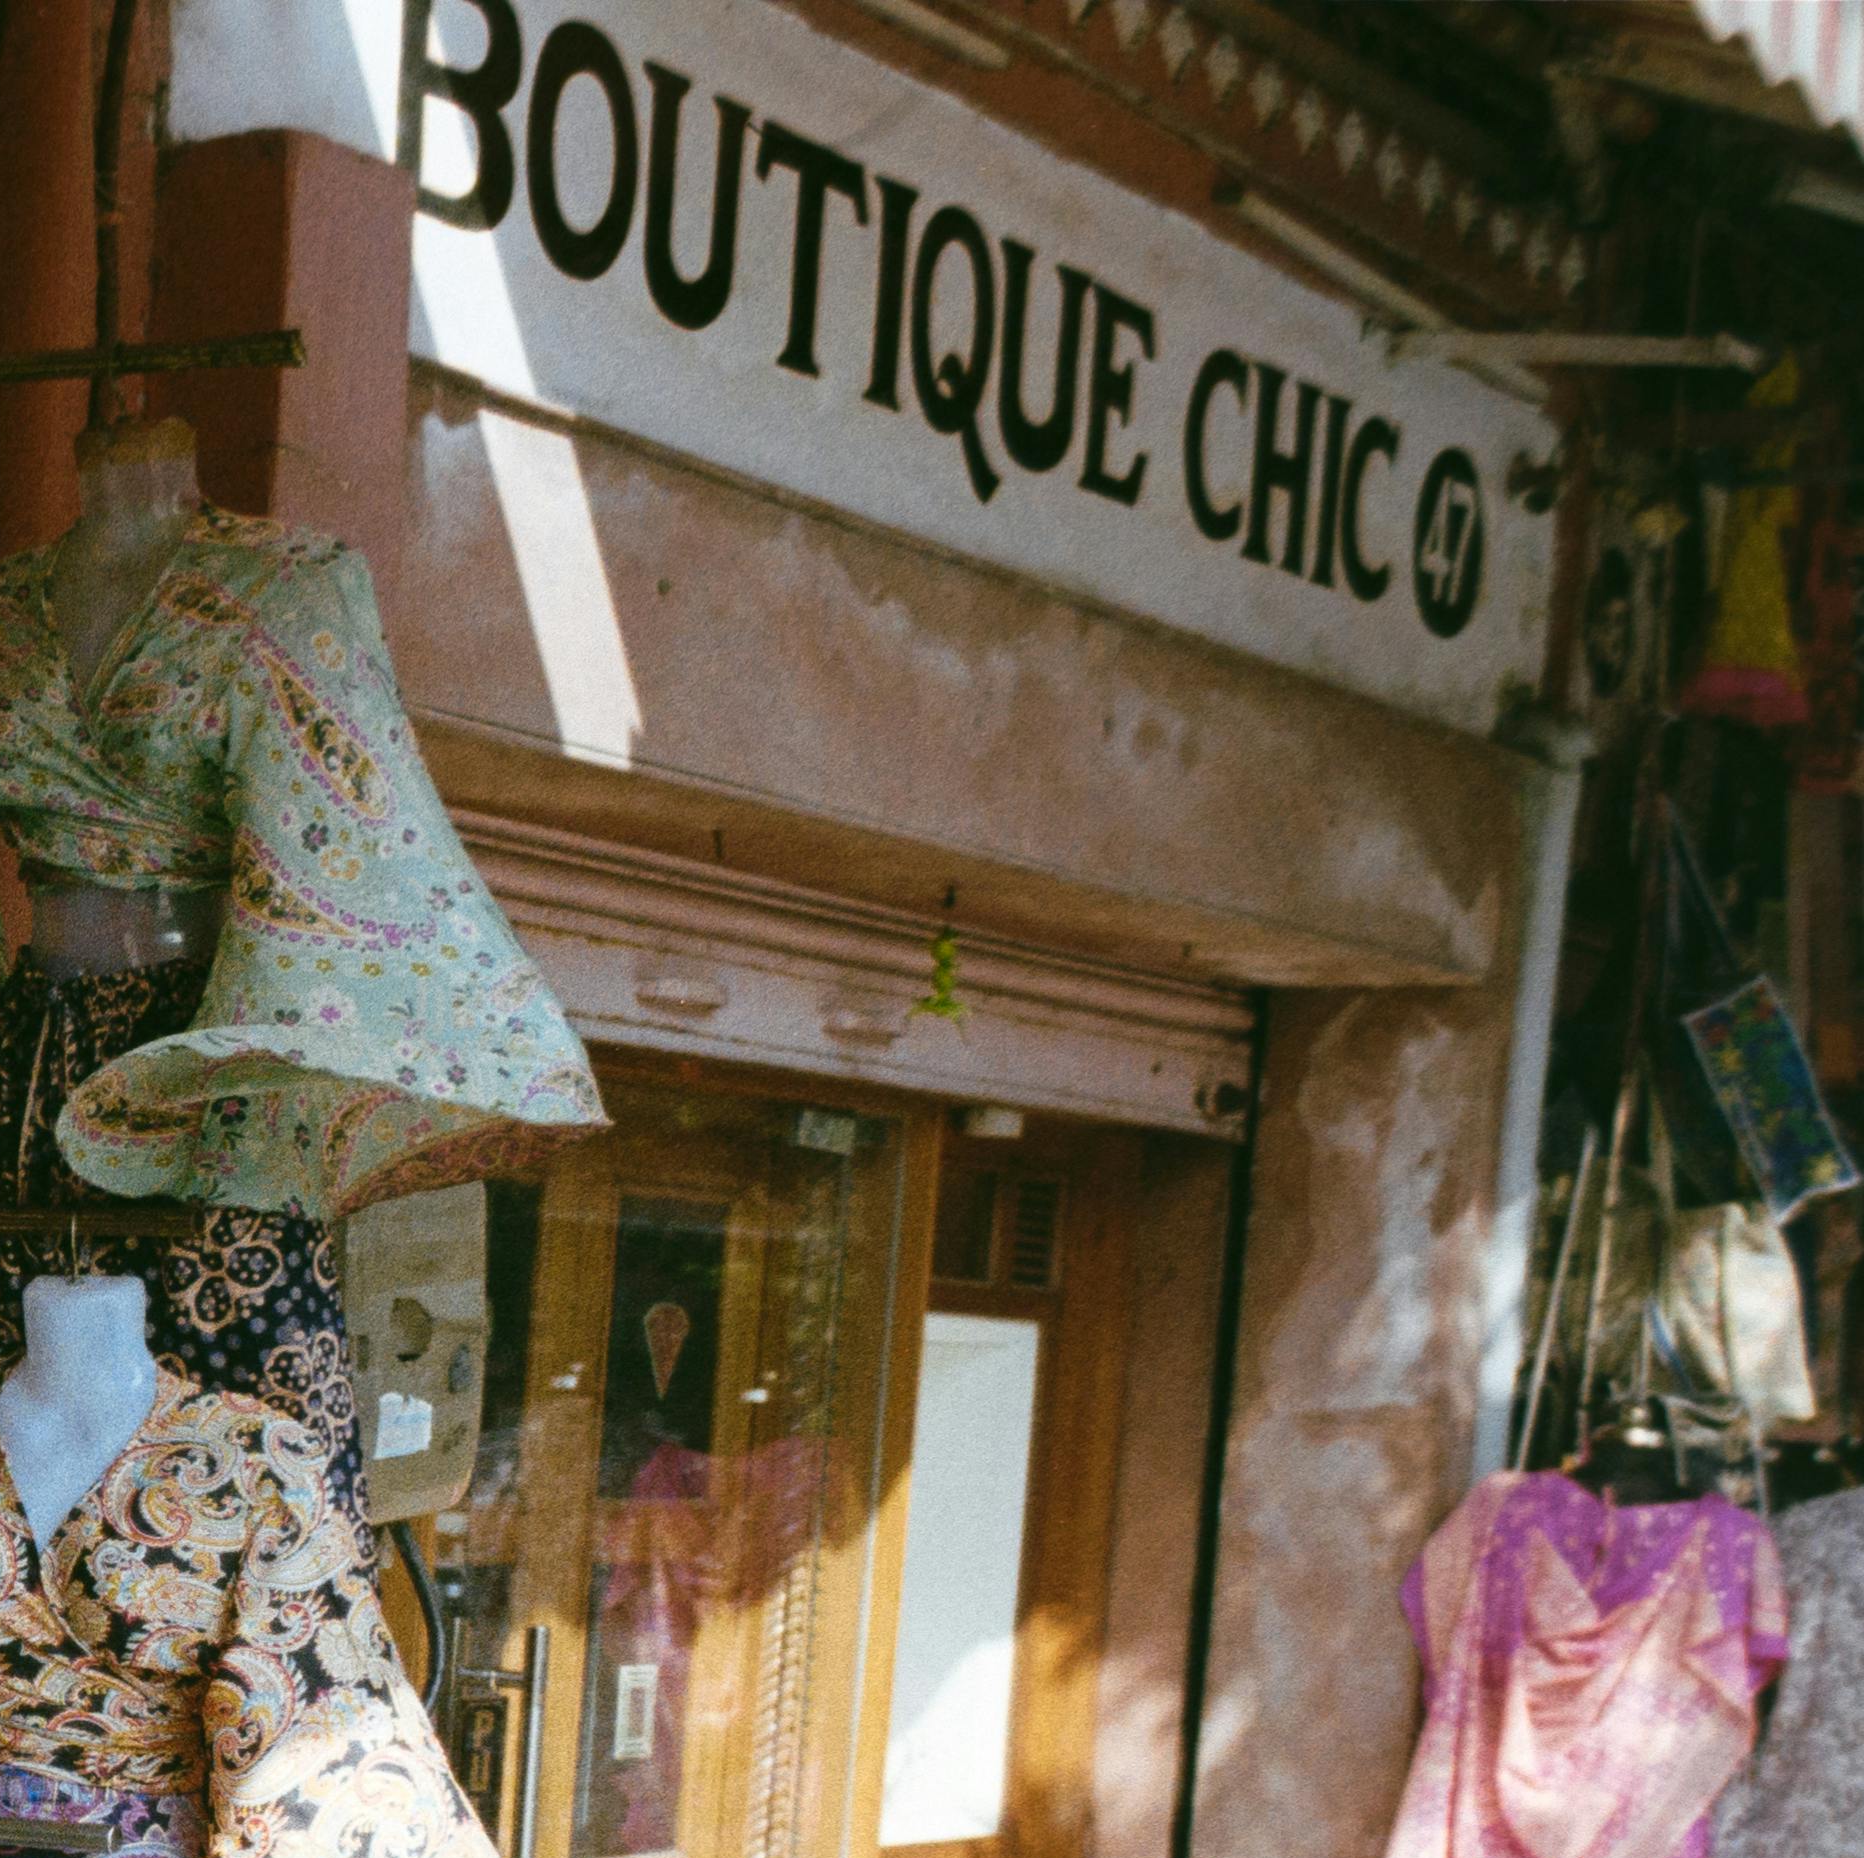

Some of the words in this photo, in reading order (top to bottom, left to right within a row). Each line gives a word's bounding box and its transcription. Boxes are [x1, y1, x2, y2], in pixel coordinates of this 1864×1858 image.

[394, 0, 1156, 505] BOUTIQUE
[1183, 348, 1401, 603] CHIC
[1421, 476, 1476, 606] 47
